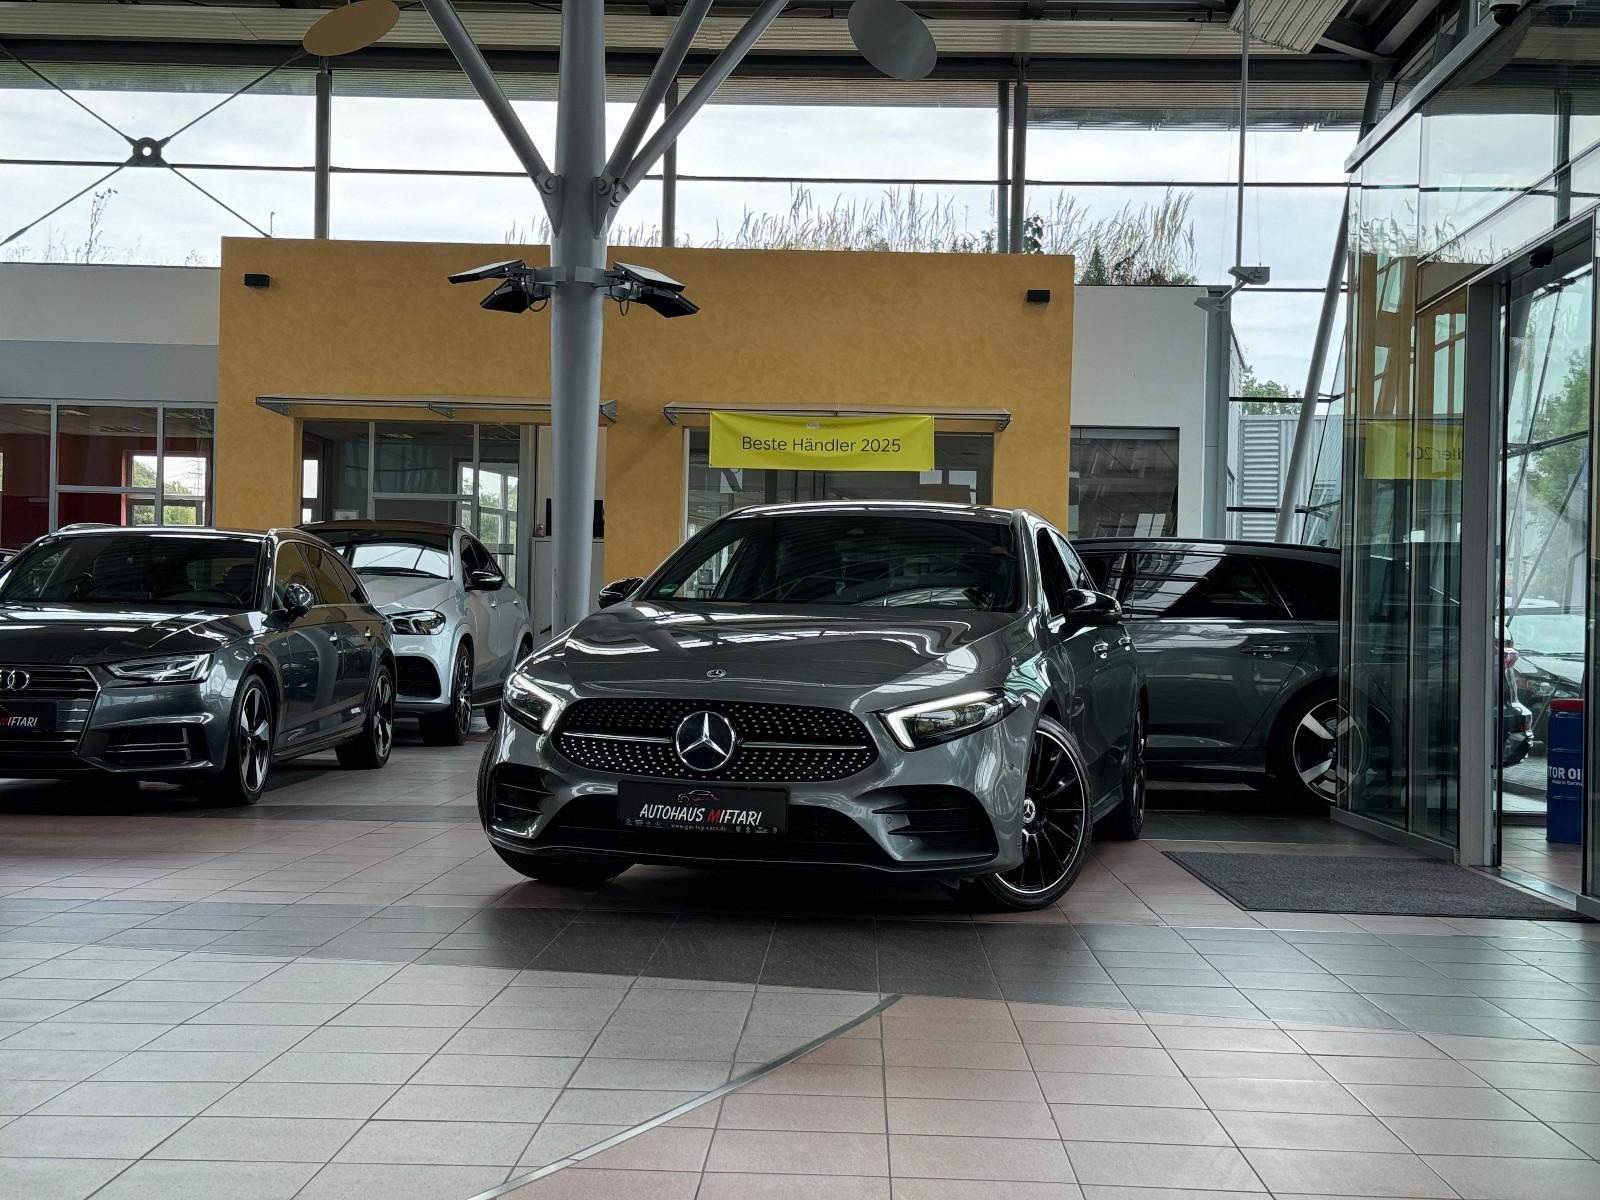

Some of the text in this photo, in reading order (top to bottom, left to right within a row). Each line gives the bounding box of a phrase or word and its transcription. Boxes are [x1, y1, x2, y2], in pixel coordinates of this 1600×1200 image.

[742, 436, 901, 453] Beste Händler 2025
[1548, 766, 1565, 779] TOR
[639, 803, 762, 826] AUTOHAUS MIFTARI
